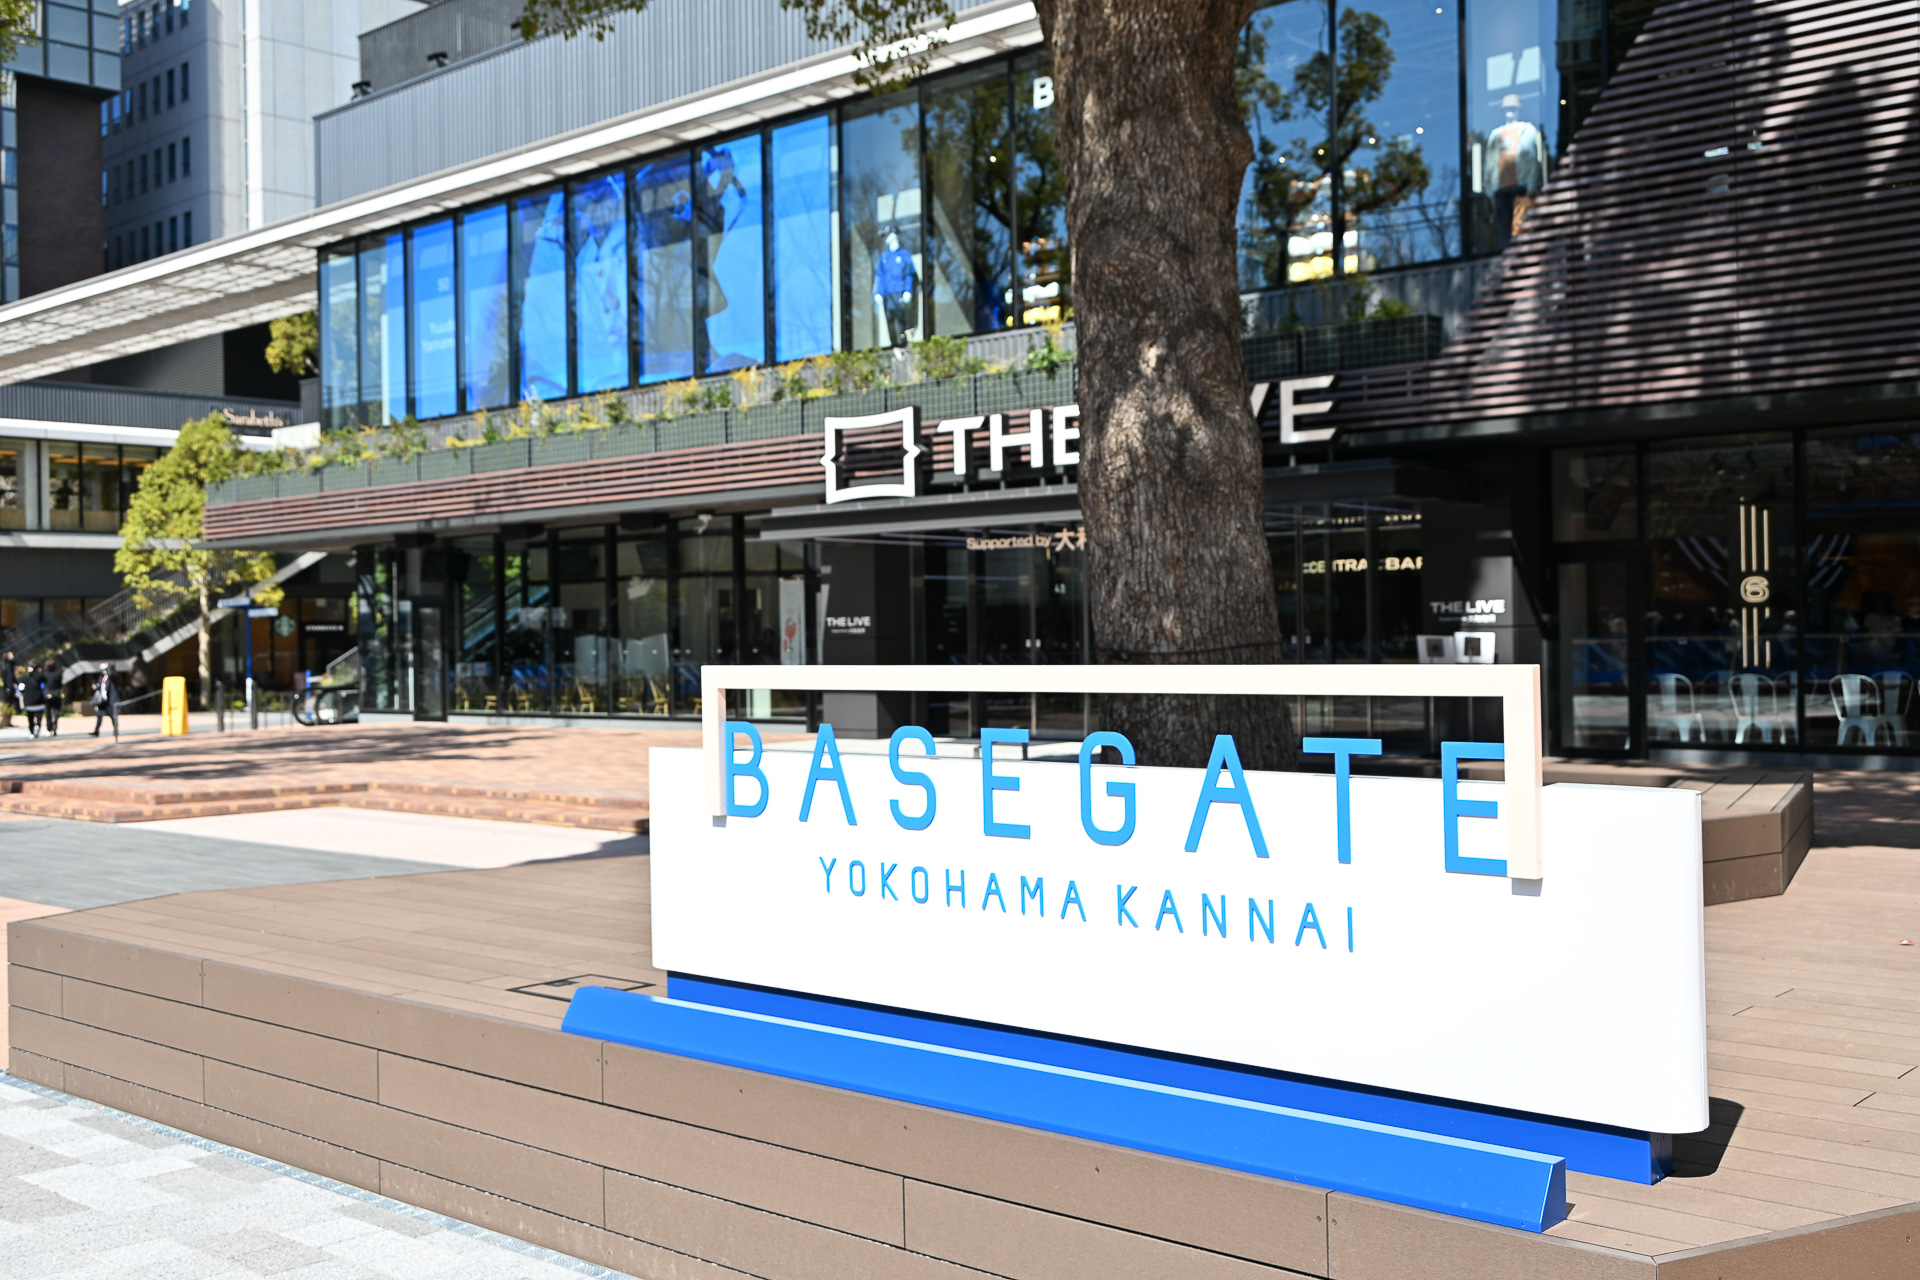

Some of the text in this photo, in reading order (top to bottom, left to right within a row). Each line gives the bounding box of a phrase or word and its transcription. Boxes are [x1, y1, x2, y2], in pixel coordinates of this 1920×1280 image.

[936, 404, 1081, 475] THE
[966, 535, 1034, 551] Supported
[1035, 533, 1052, 548] by
[826, 615, 871, 628] THE LIVE
[1430, 599, 1505, 614] THE LIVE
[725, 721, 1507, 877] BASEGATE
[819, 856, 1354, 953] YOKOHAMA KANNAI
